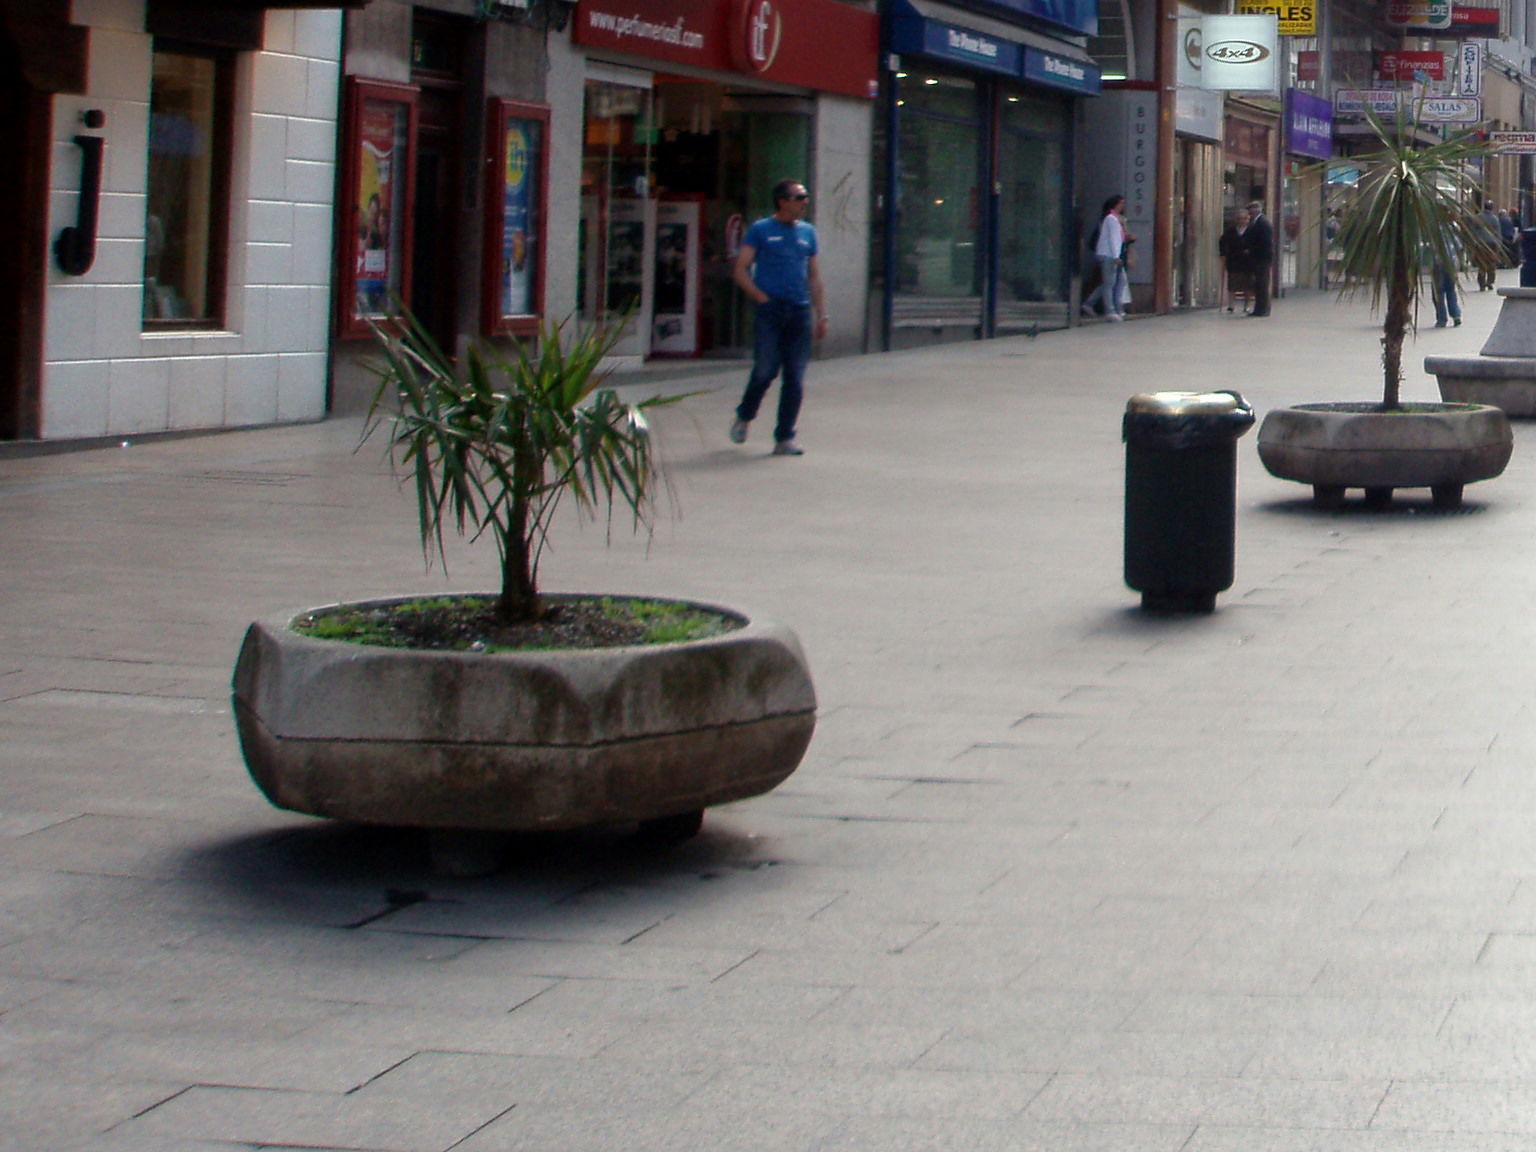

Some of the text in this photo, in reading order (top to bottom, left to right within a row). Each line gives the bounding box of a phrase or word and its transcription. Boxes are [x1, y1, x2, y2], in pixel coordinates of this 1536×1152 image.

[948, 29, 998, 57] The Phone House
[1212, 46, 1255, 58] 4x4
[1044, 55, 1085, 80] The Phone House
[1400, 58, 1441, 70] finanzas
[1427, 102, 1462, 113] SALAS
